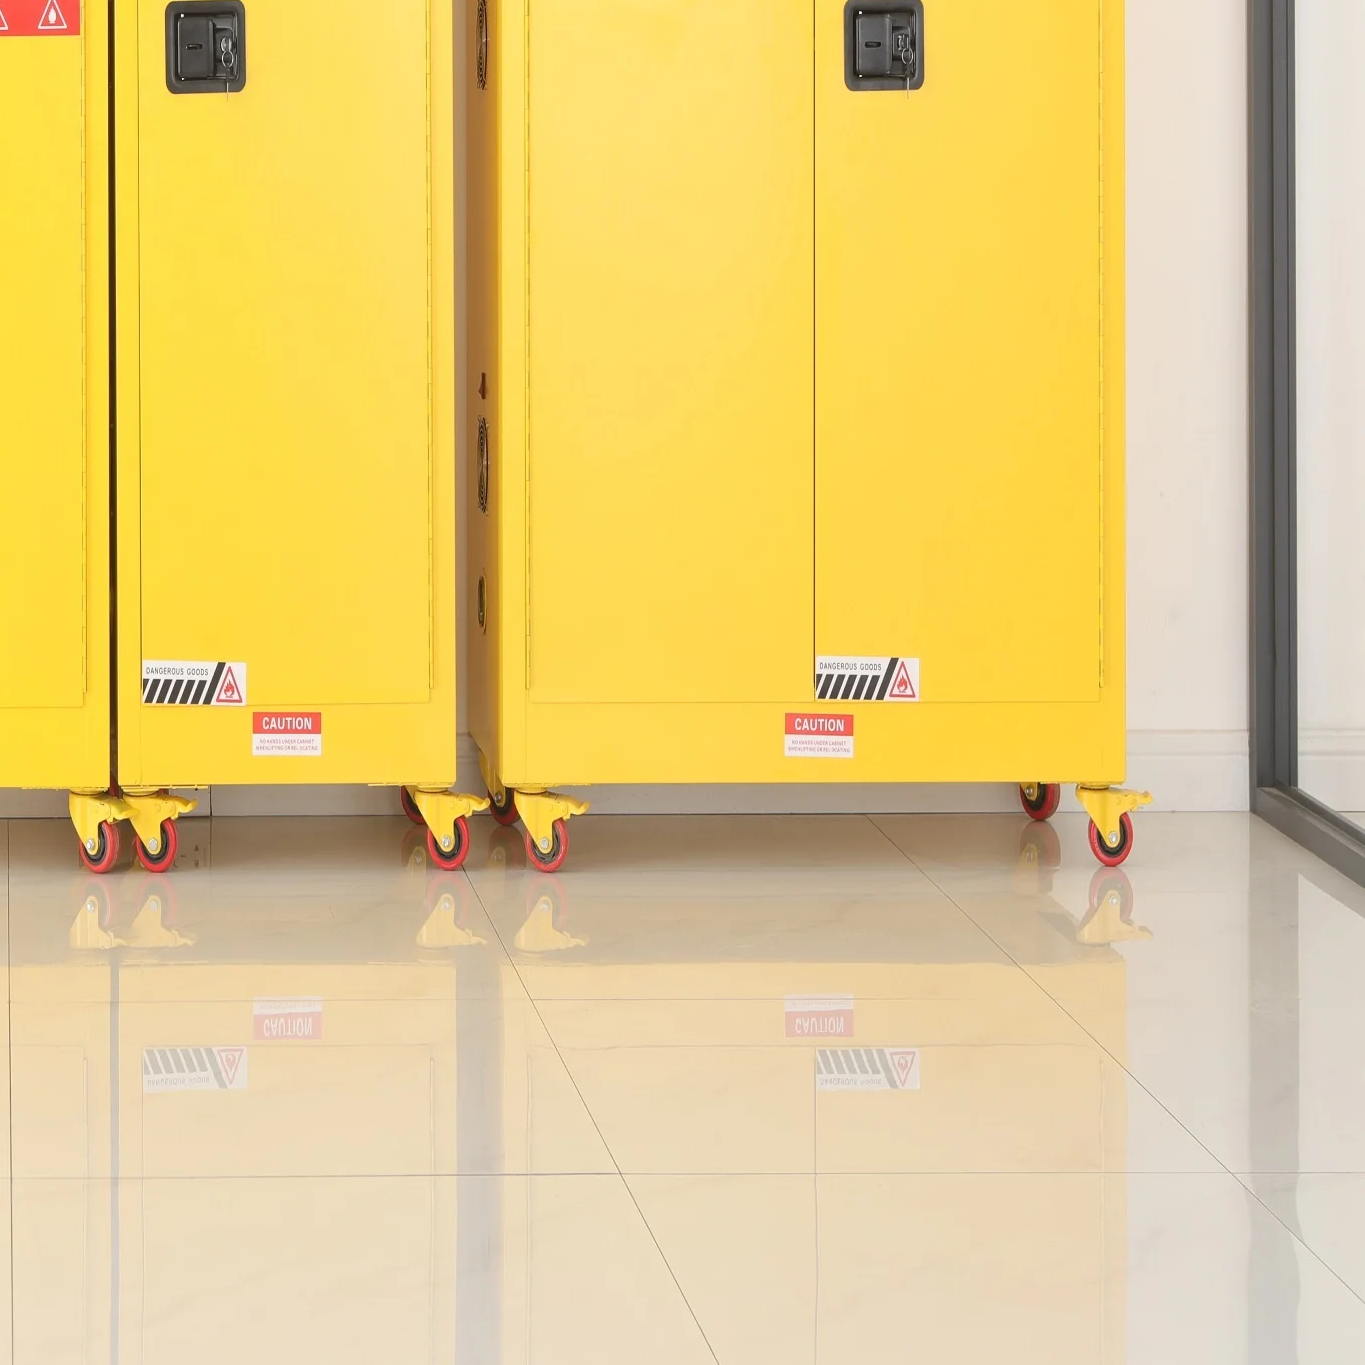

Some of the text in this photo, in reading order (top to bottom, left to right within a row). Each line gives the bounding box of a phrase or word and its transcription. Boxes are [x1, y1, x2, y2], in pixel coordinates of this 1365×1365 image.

[146, 667, 208, 676] DANGEROUS GOODS
[819, 662, 881, 671] DANGEROUS GOODS
[262, 717, 312, 730] CAUTION
[795, 718, 844, 731] CAUTION
